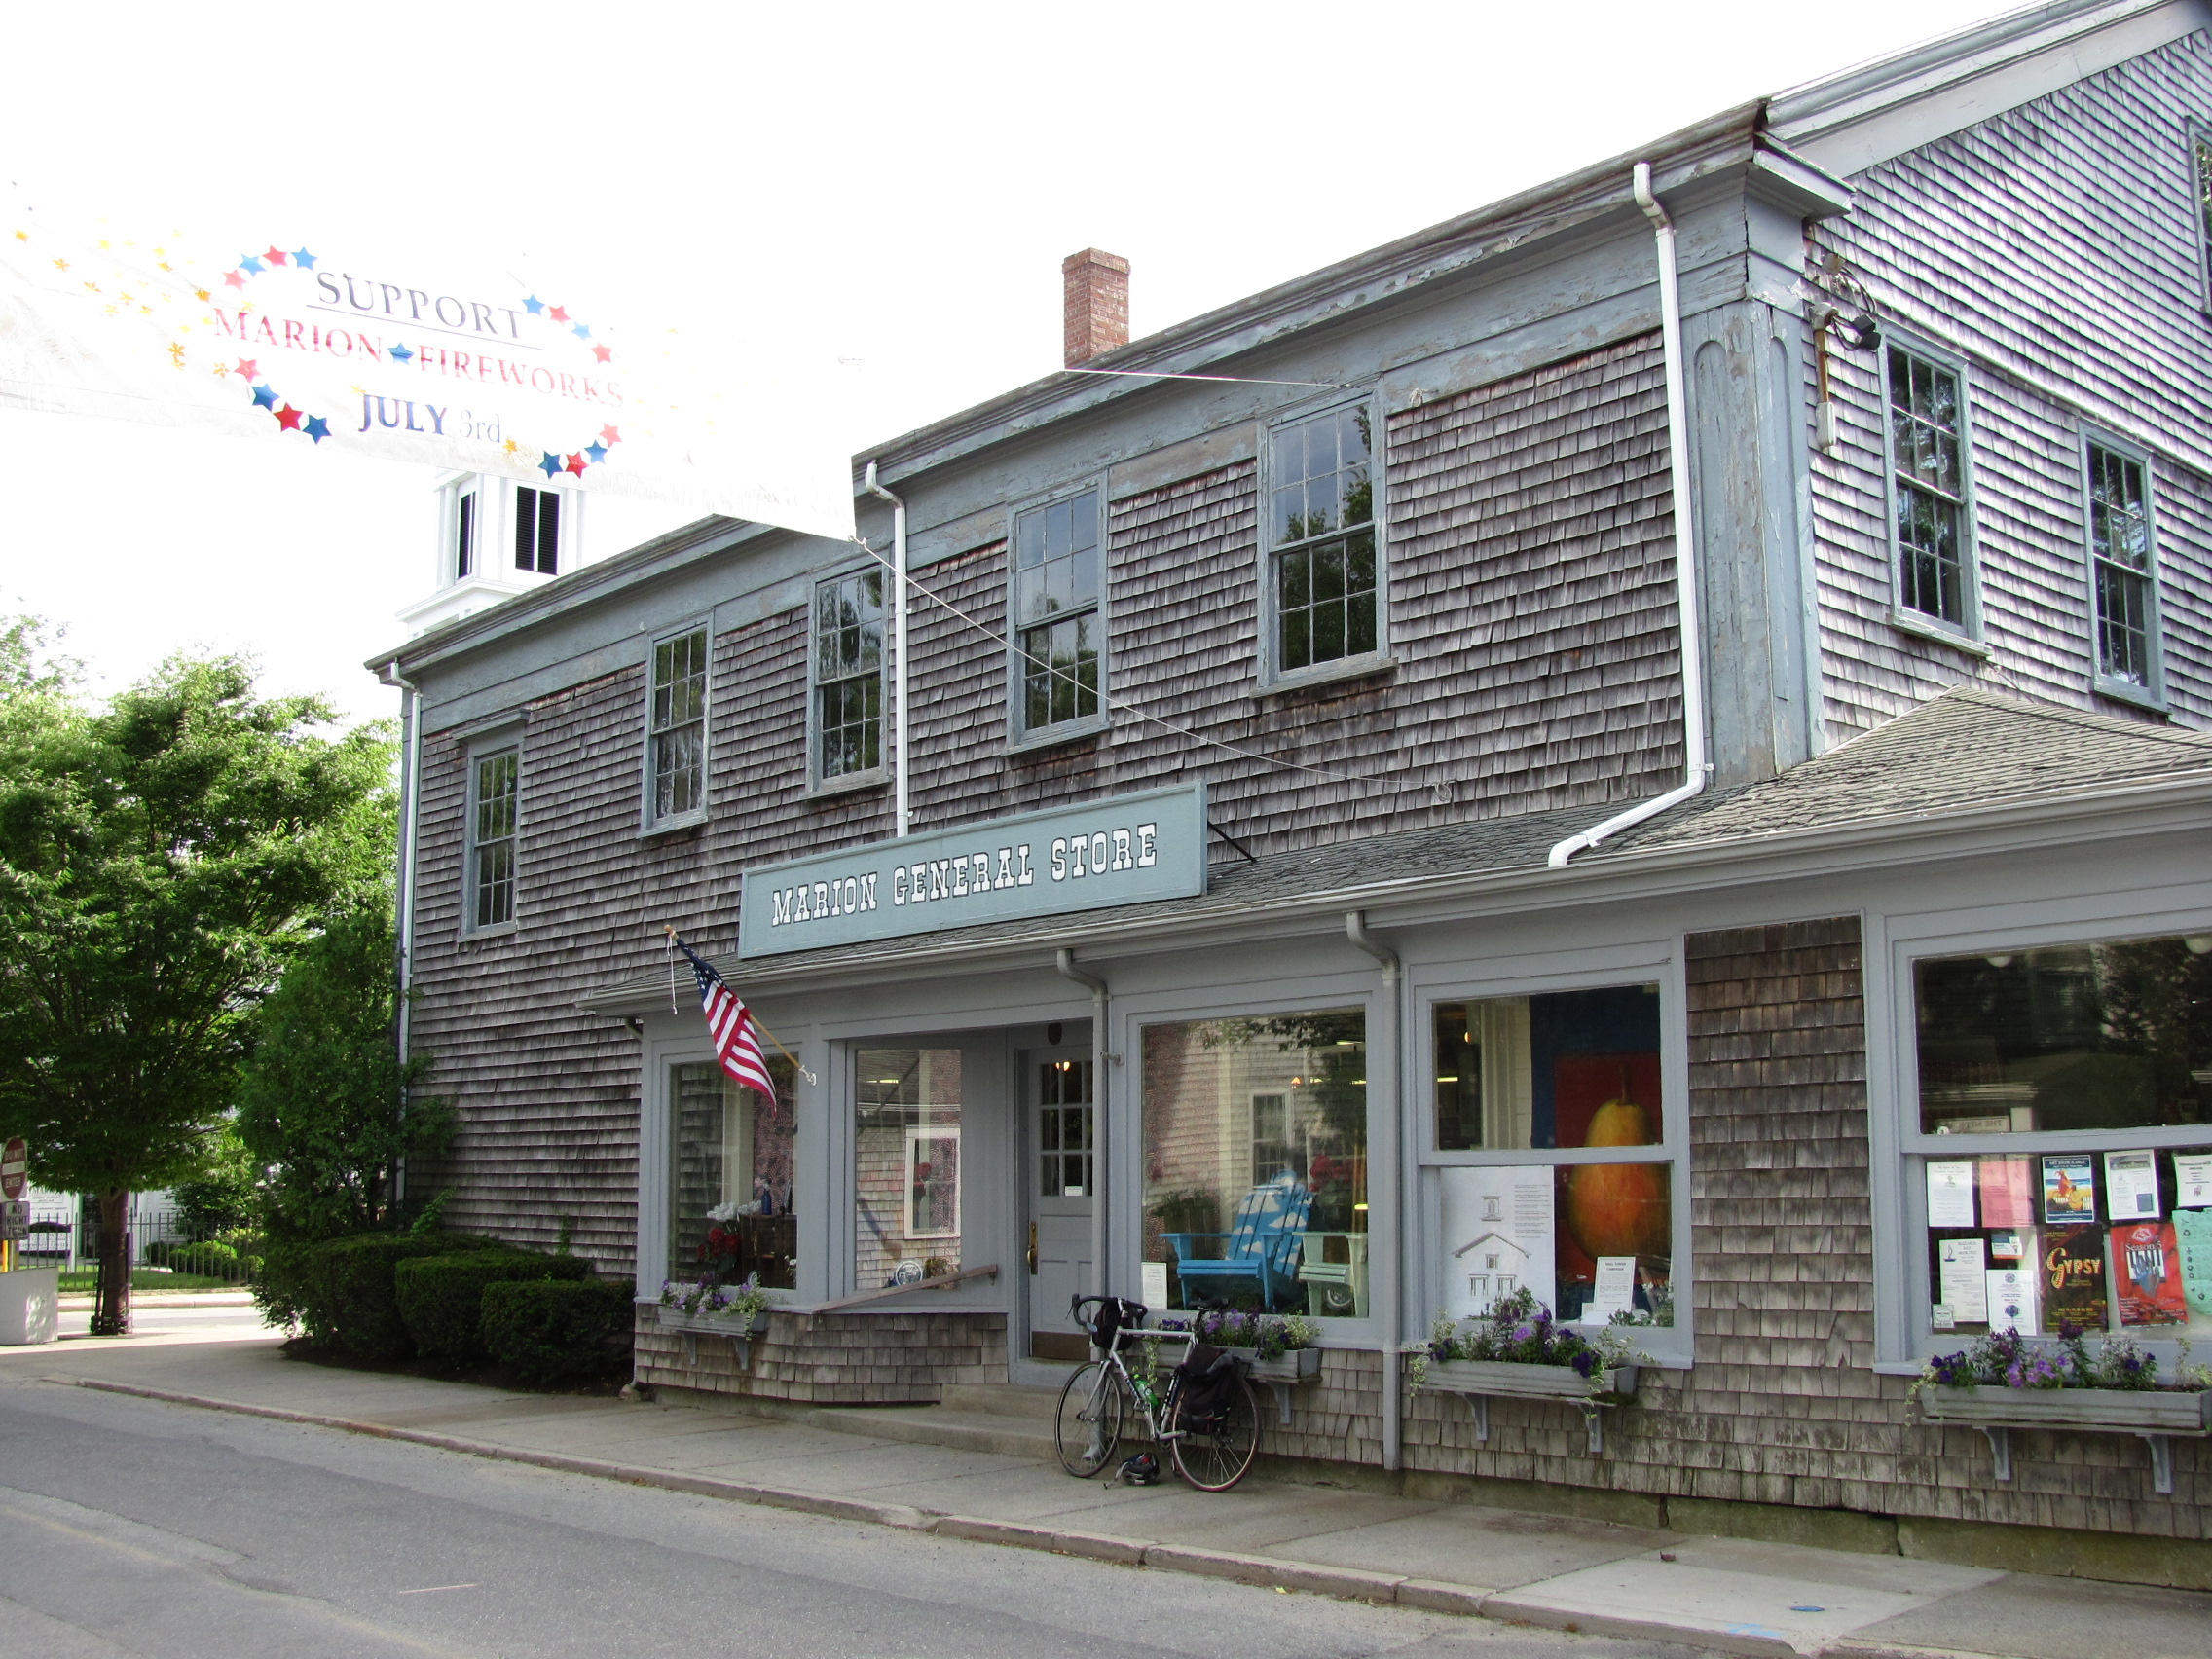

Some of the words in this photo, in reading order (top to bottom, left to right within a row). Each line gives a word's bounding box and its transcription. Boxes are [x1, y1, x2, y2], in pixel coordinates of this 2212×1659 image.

[315, 271, 523, 340] SUPPORT
[211, 307, 384, 364] MARION
[418, 344, 624, 409] FIREWORKS
[358, 393, 448, 436] JULY
[458, 409, 502, 443] 3rd
[771, 871, 878, 928] MARION
[892, 843, 1034, 907] GENERAL
[1050, 821, 1159, 882] STORE
[6, 1176, 21, 1188] ENTER
[7, 1215, 28, 1226] RIGHT
[13, 1204, 23, 1215] NO
[2046, 1247, 2101, 1290] GYPSY
[2125, 1243, 2155, 1252] Season
